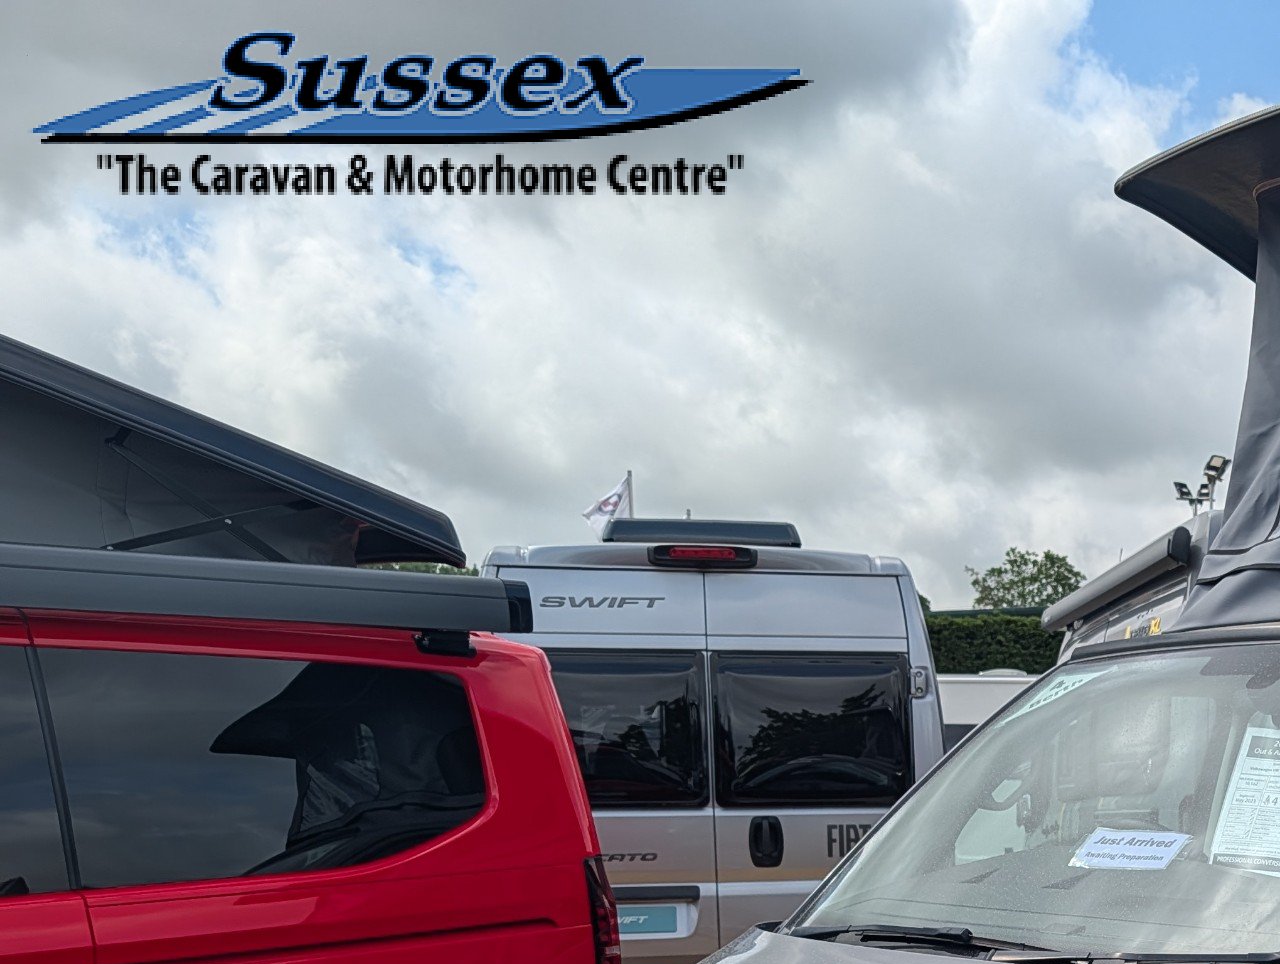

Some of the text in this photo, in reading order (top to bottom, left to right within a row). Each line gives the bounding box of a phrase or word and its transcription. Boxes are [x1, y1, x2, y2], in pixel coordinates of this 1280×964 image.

[539, 596, 666, 608] SWIFT
[1093, 836, 1177, 848] Just Arrived
[1084, 851, 1164, 862] Awaiting Preparation
